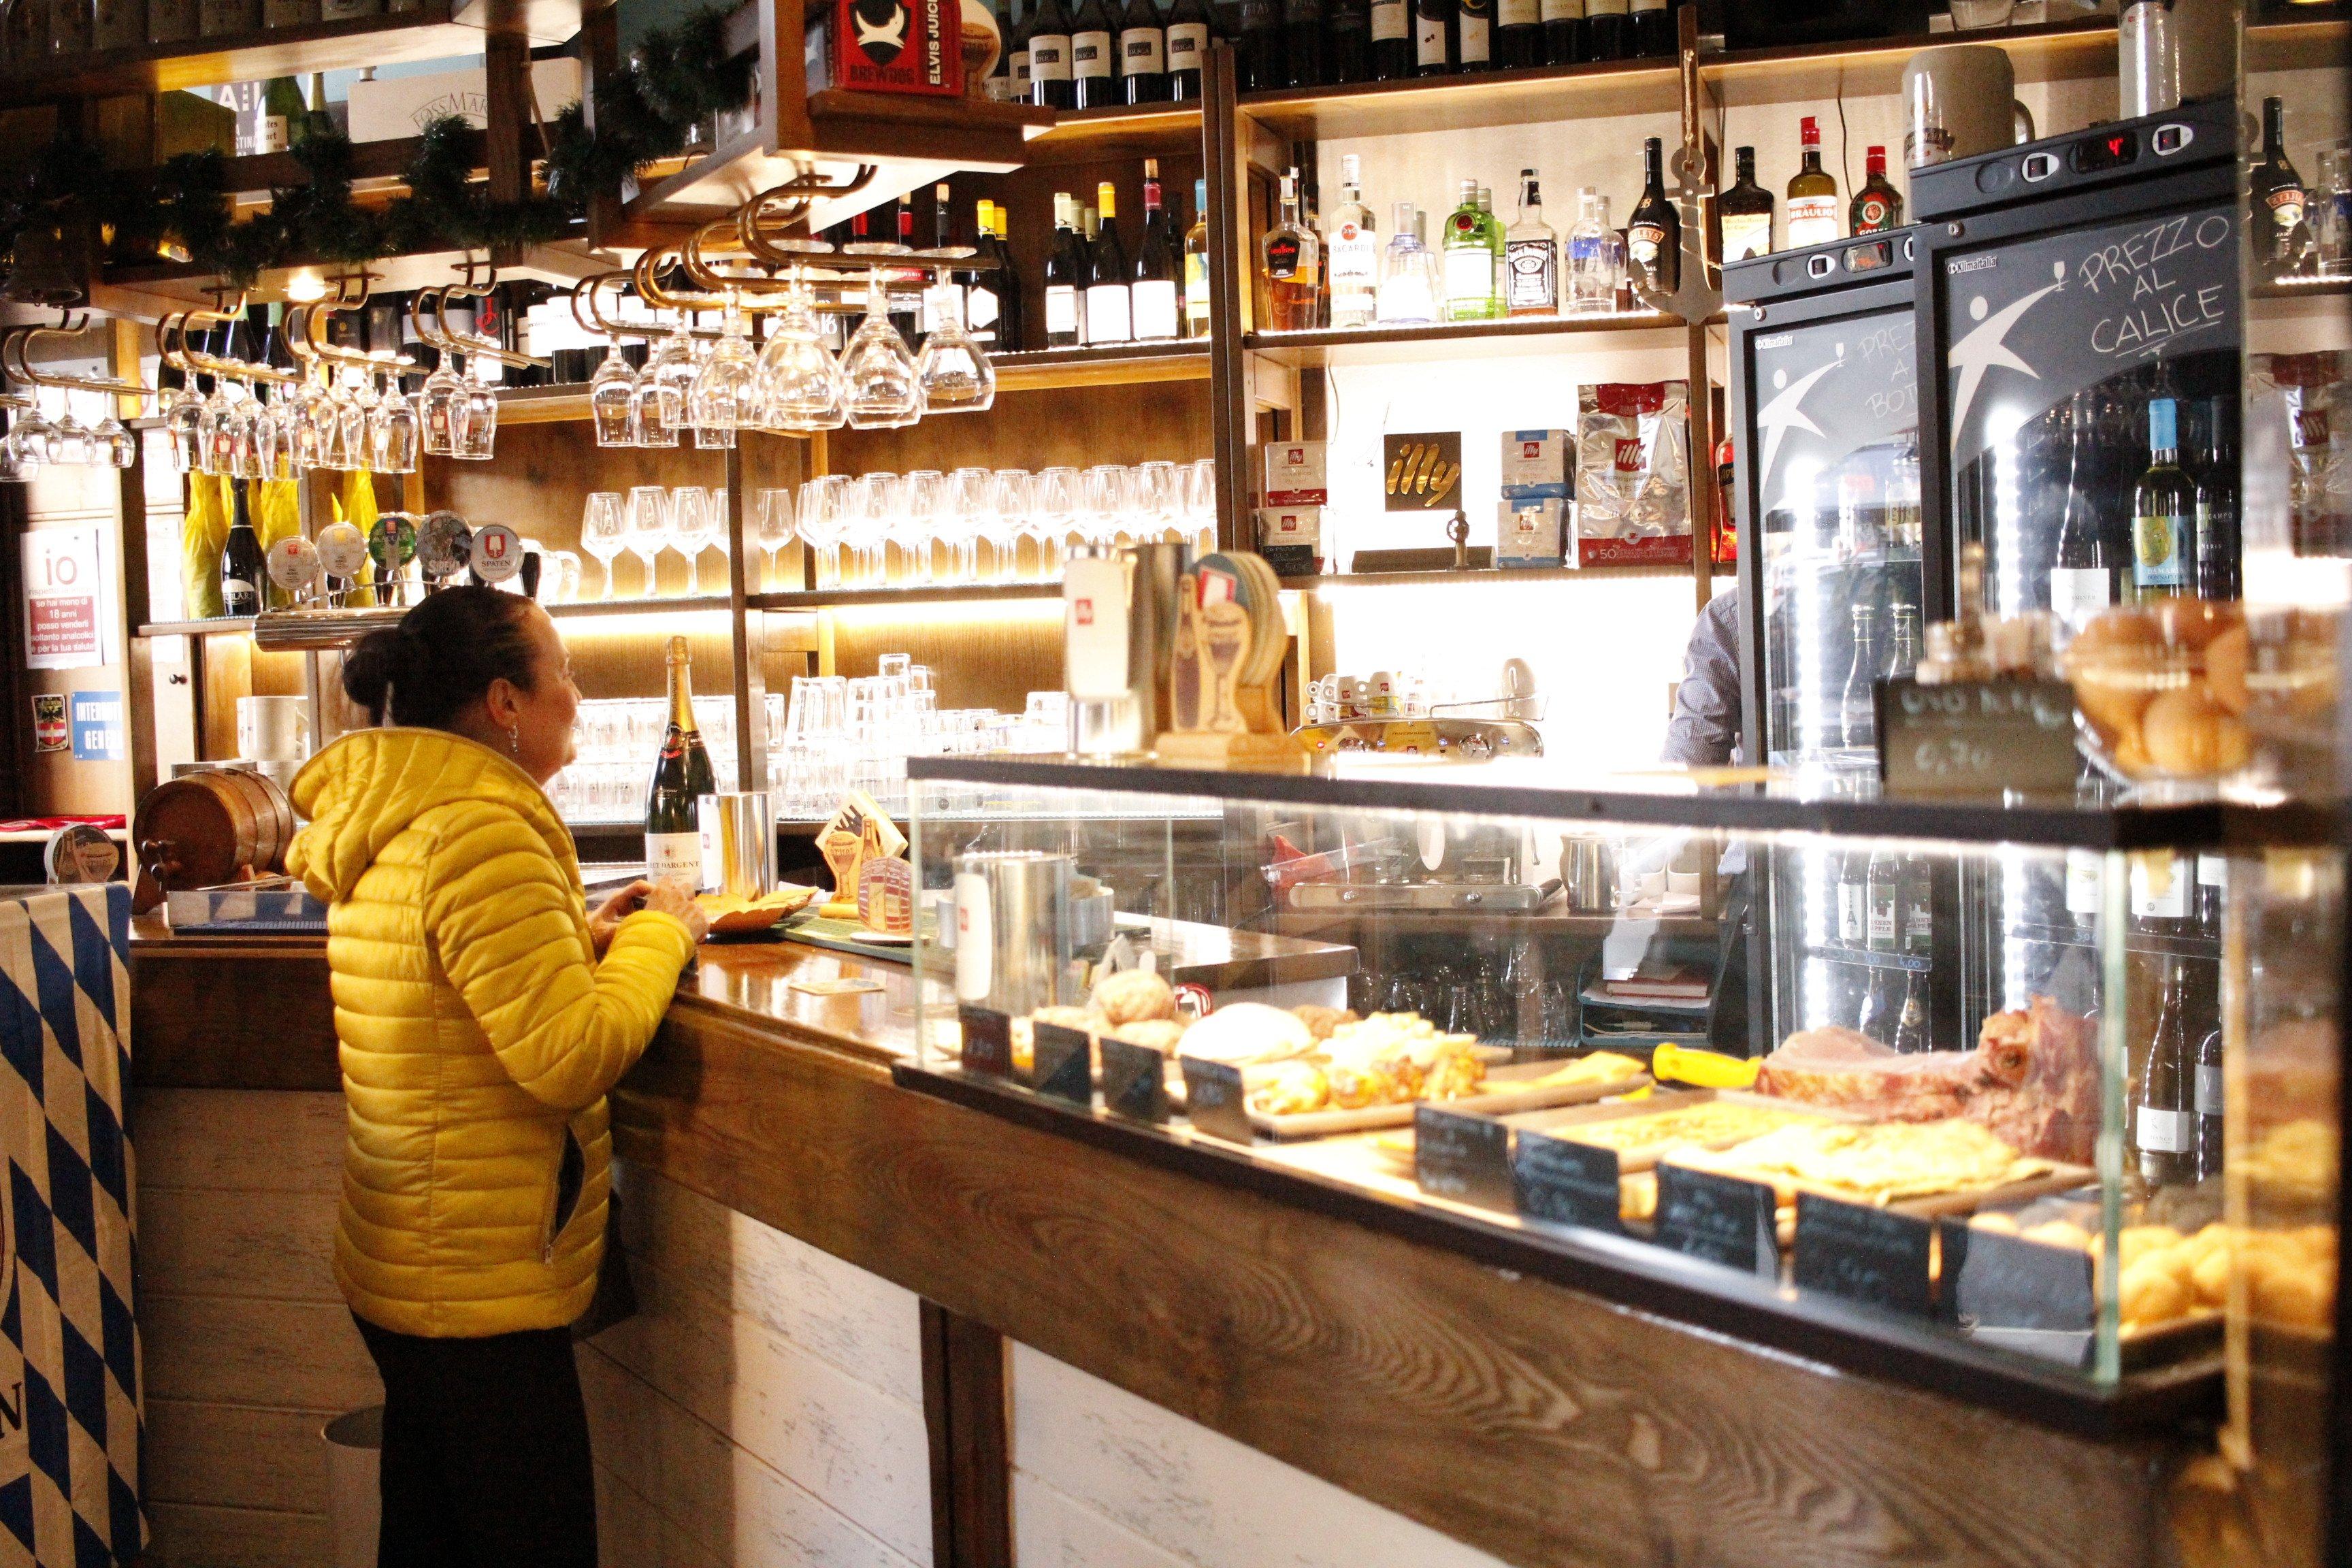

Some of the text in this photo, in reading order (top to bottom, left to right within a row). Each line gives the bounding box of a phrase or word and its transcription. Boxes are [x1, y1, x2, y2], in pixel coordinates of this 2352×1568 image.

[927, 0, 941, 85] ELVIS JUIC
[1036, 54, 1058, 63] DUGA
[1791, 208, 1834, 218] BRAULIO
[1333, 243, 1370, 253] BACARDI
[2078, 215, 2230, 293] PREZZO
[1957, 255, 1997, 272] Klimaitalia
[2133, 269, 2176, 301] AL
[2091, 284, 2225, 353] CALICE
[1386, 442, 1461, 508] illy
[1599, 550, 1616, 559] 50
[46, 548, 77, 586] io
[481, 559, 511, 568] SPATEN
[29, 587, 59, 596] rispetto
[47, 599, 58, 607] hai
[60, 599, 80, 607] meno
[50, 609, 60, 619] 18
[37, 619, 89, 630] posso venderti
[37, 645, 49, 654] per
[1897, 957, 1921, 968] 4,00
